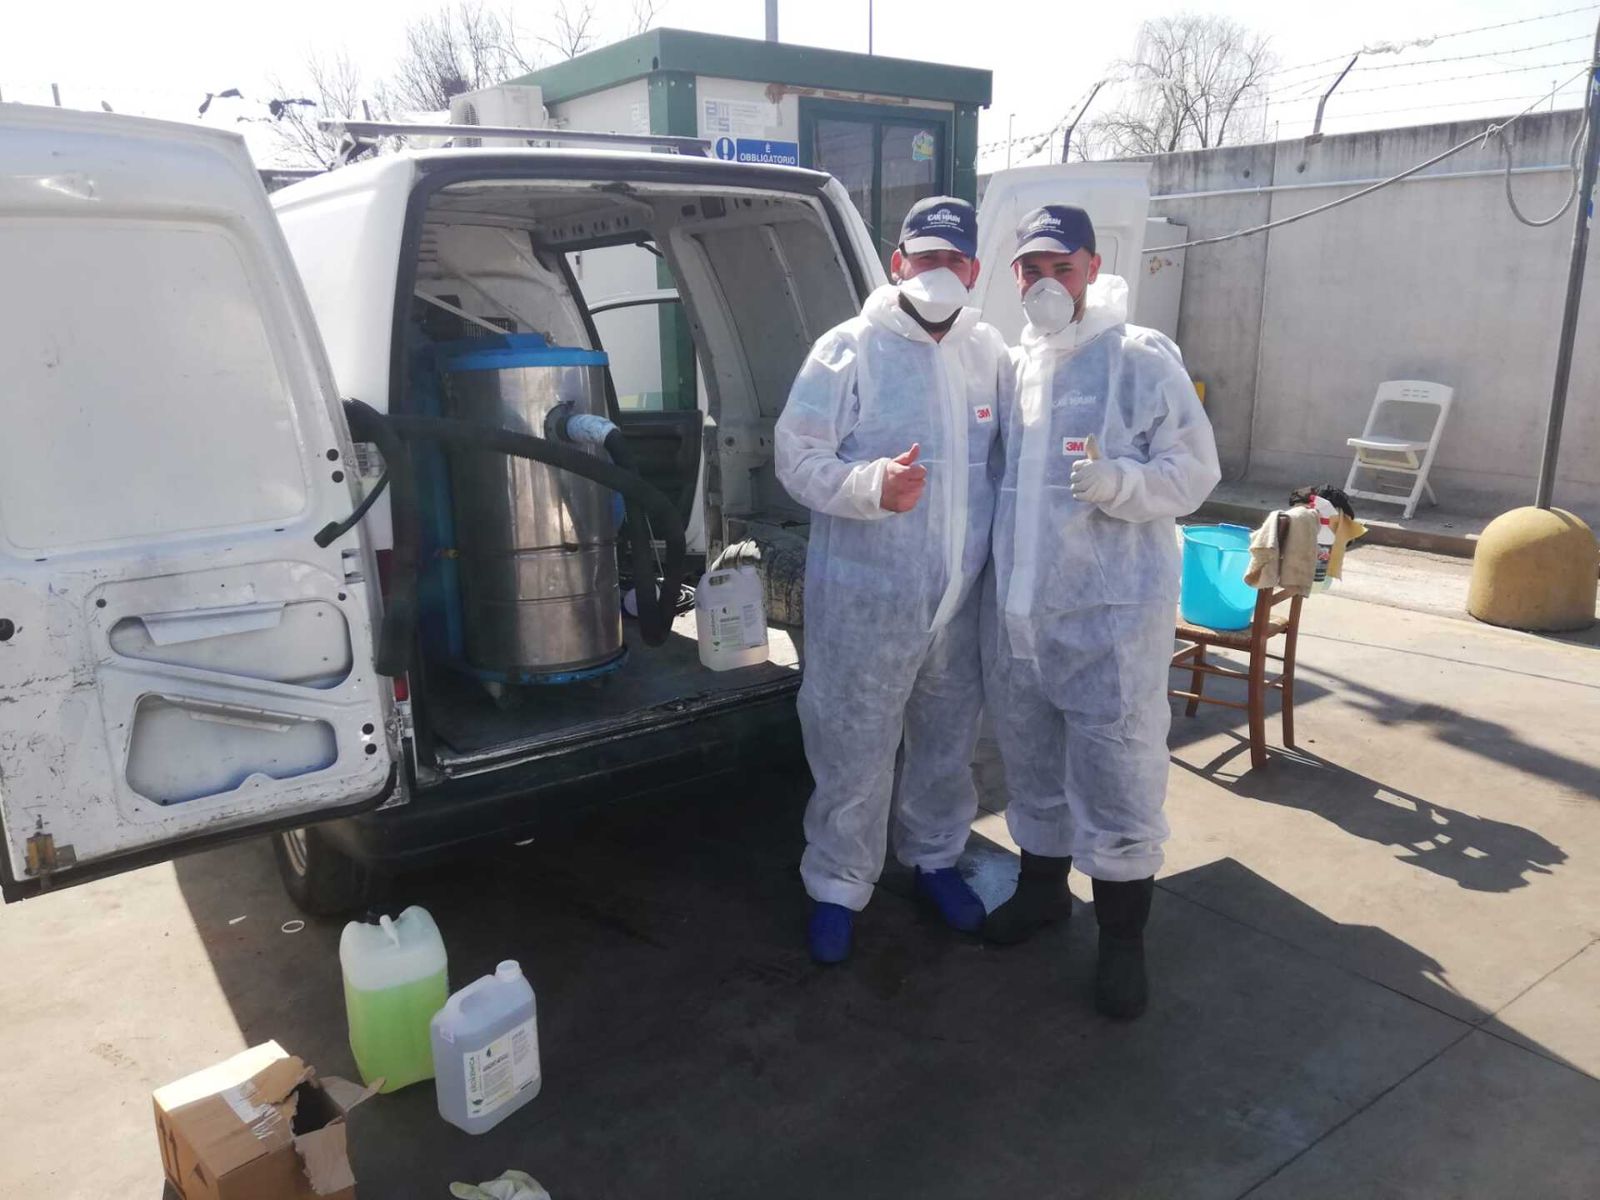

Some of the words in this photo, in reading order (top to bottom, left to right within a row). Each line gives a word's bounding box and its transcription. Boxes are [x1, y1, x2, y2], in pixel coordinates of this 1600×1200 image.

[765, 143, 771, 153] È
[741, 153, 796, 164] OBBLIGATORIO
[977, 409, 991, 418] 3M
[1065, 442, 1084, 452] 3M
